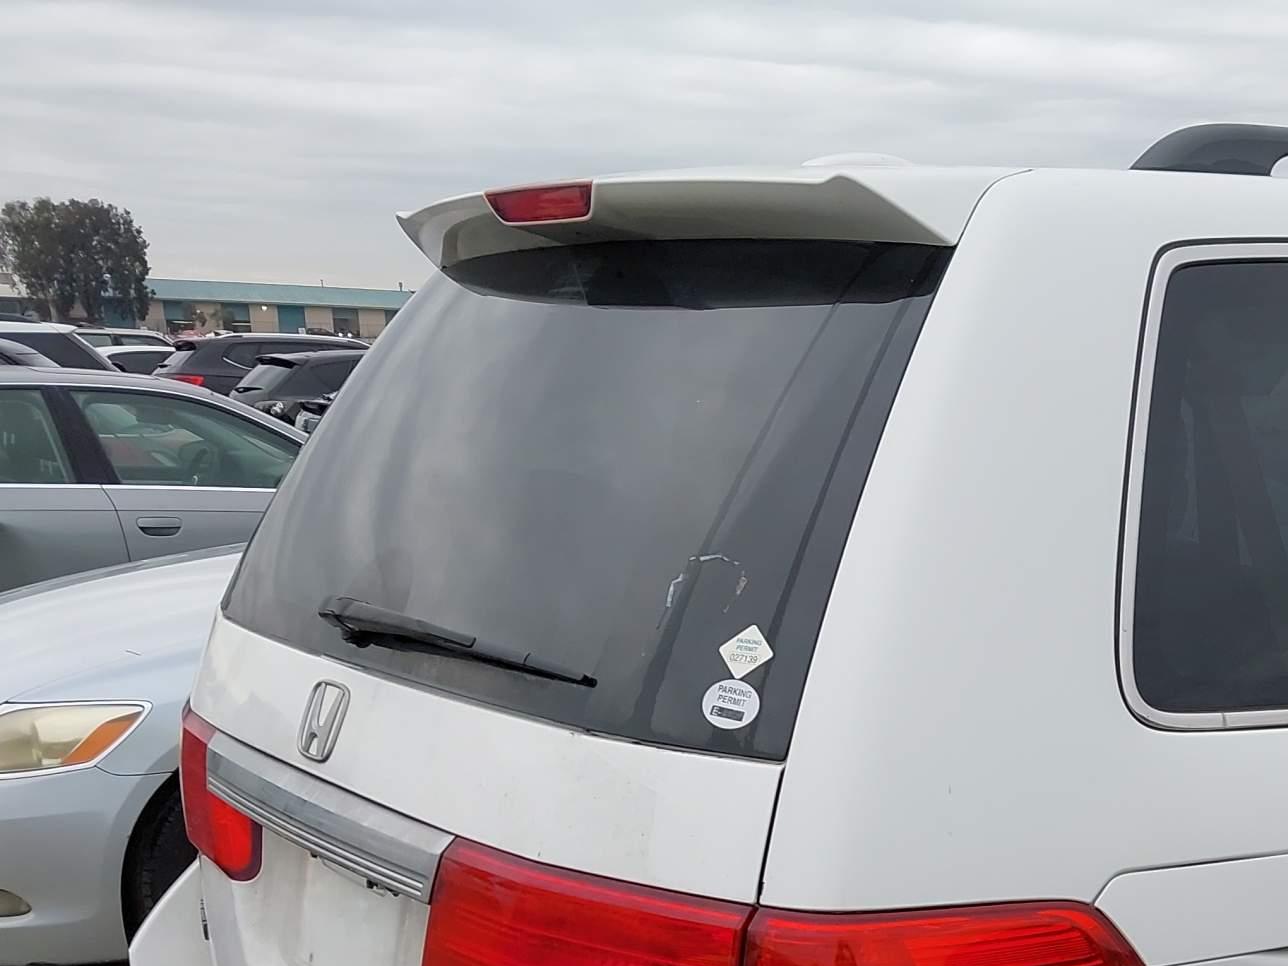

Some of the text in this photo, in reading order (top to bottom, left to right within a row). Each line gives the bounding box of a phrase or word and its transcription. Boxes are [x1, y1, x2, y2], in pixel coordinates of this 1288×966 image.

[736, 638, 762, 647] PARKING
[735, 645, 758, 653] PERMIT
[718, 684, 752, 699] PARKING
[717, 694, 748, 707] PERMIT
